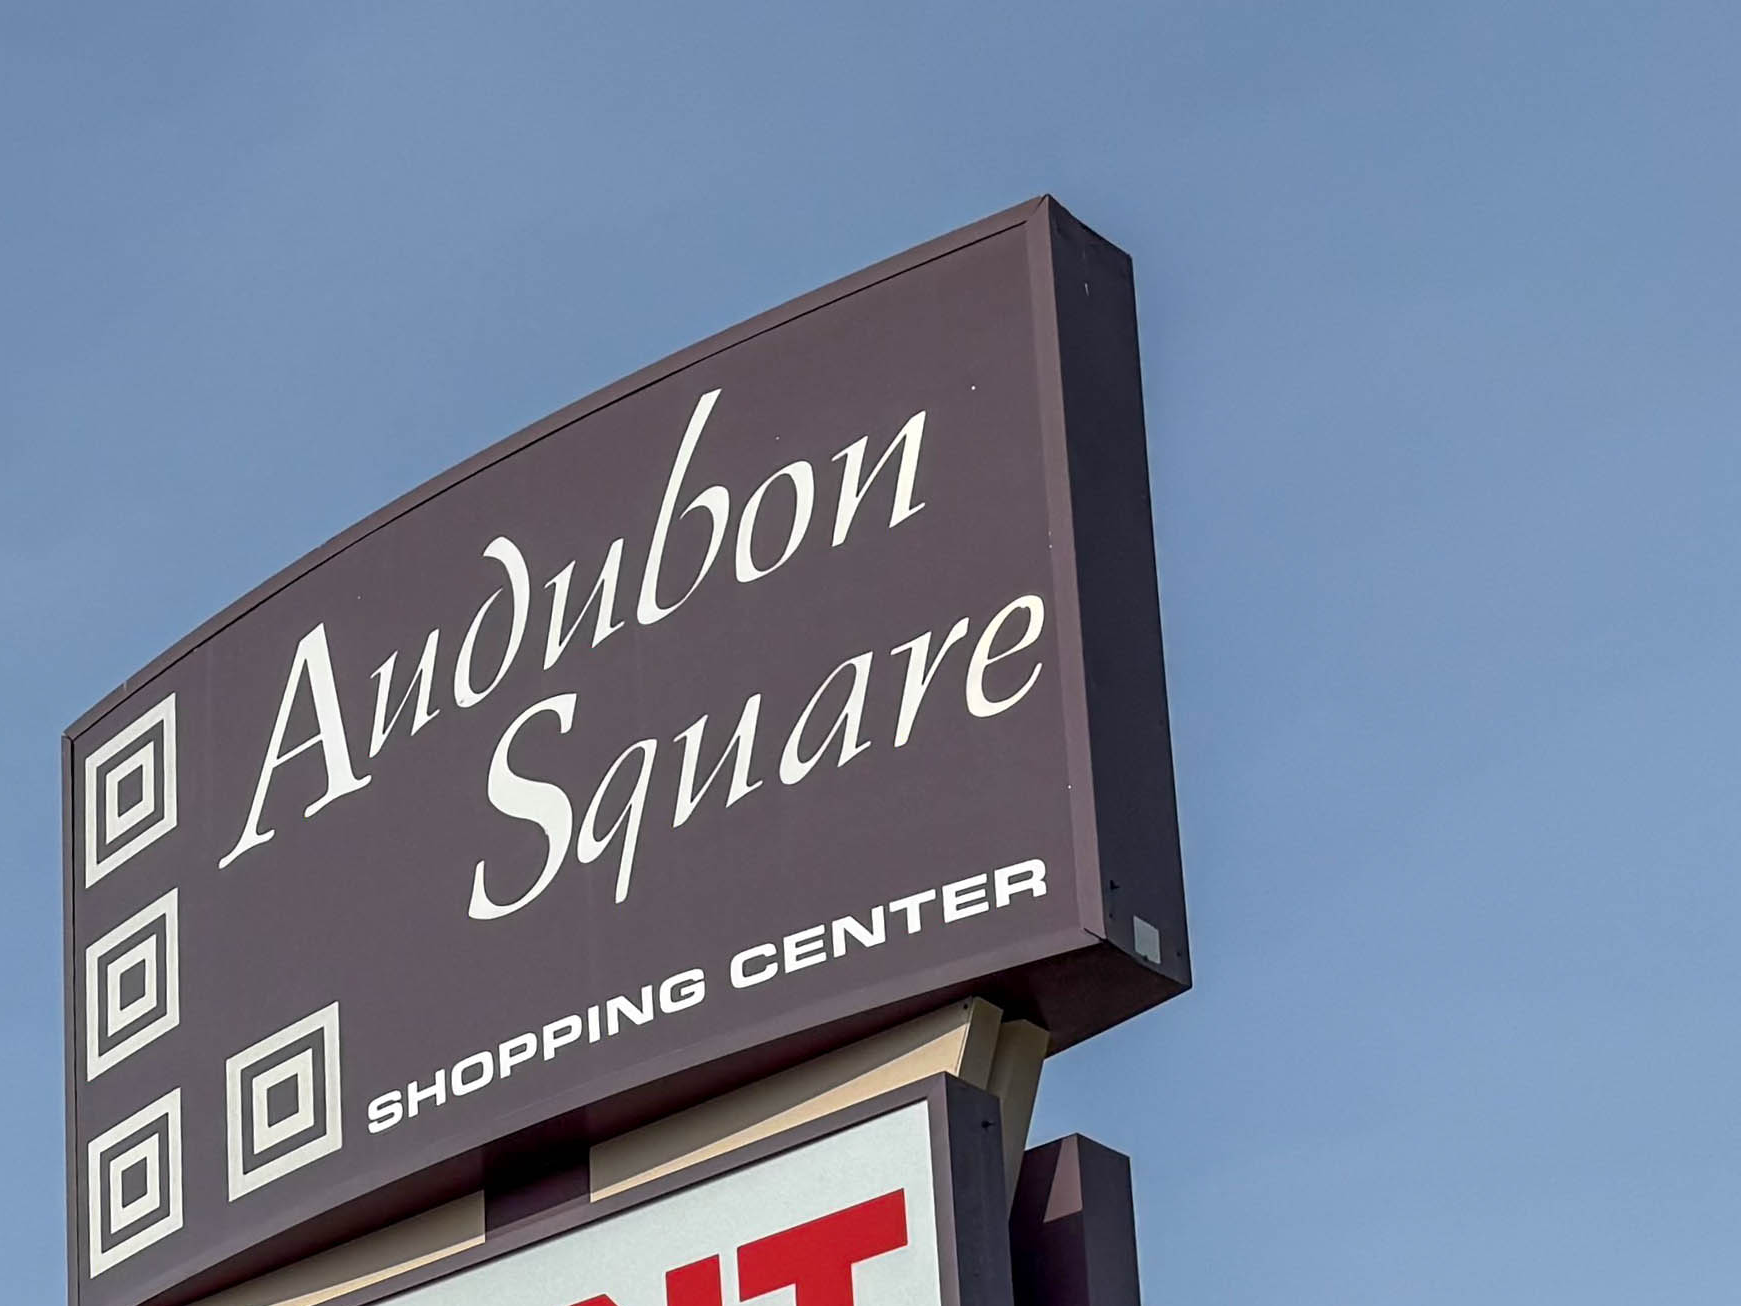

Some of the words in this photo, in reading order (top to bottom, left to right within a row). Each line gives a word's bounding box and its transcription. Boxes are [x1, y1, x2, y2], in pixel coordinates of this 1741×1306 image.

[218, 388, 926, 868] Audubon
[467, 594, 1045, 920] Square
[367, 967, 706, 1135] SHOPPING
[730, 858, 1048, 989] CENTER
